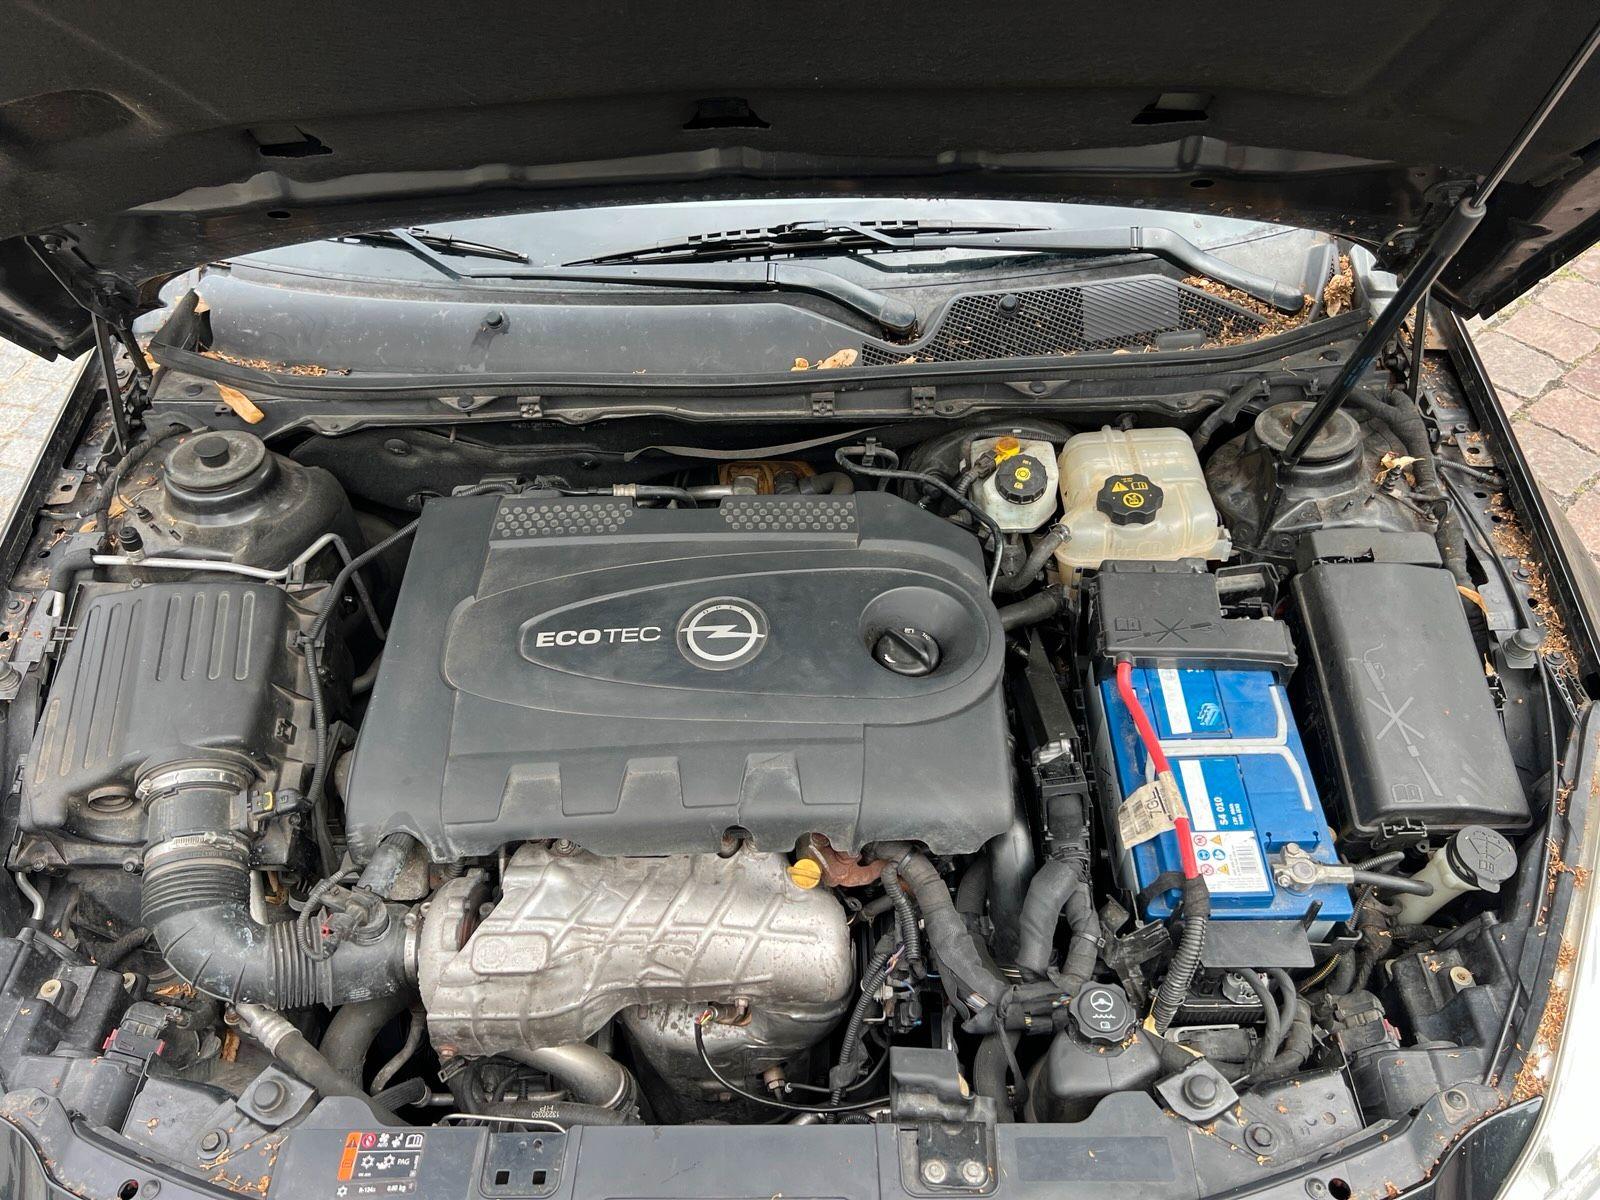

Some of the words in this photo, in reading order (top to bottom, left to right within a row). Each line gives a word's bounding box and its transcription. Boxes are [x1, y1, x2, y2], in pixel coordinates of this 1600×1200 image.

[535, 626, 662, 648] ECOTEC
[1213, 796, 1225, 812] 010
[1219, 813, 1229, 826] S4
